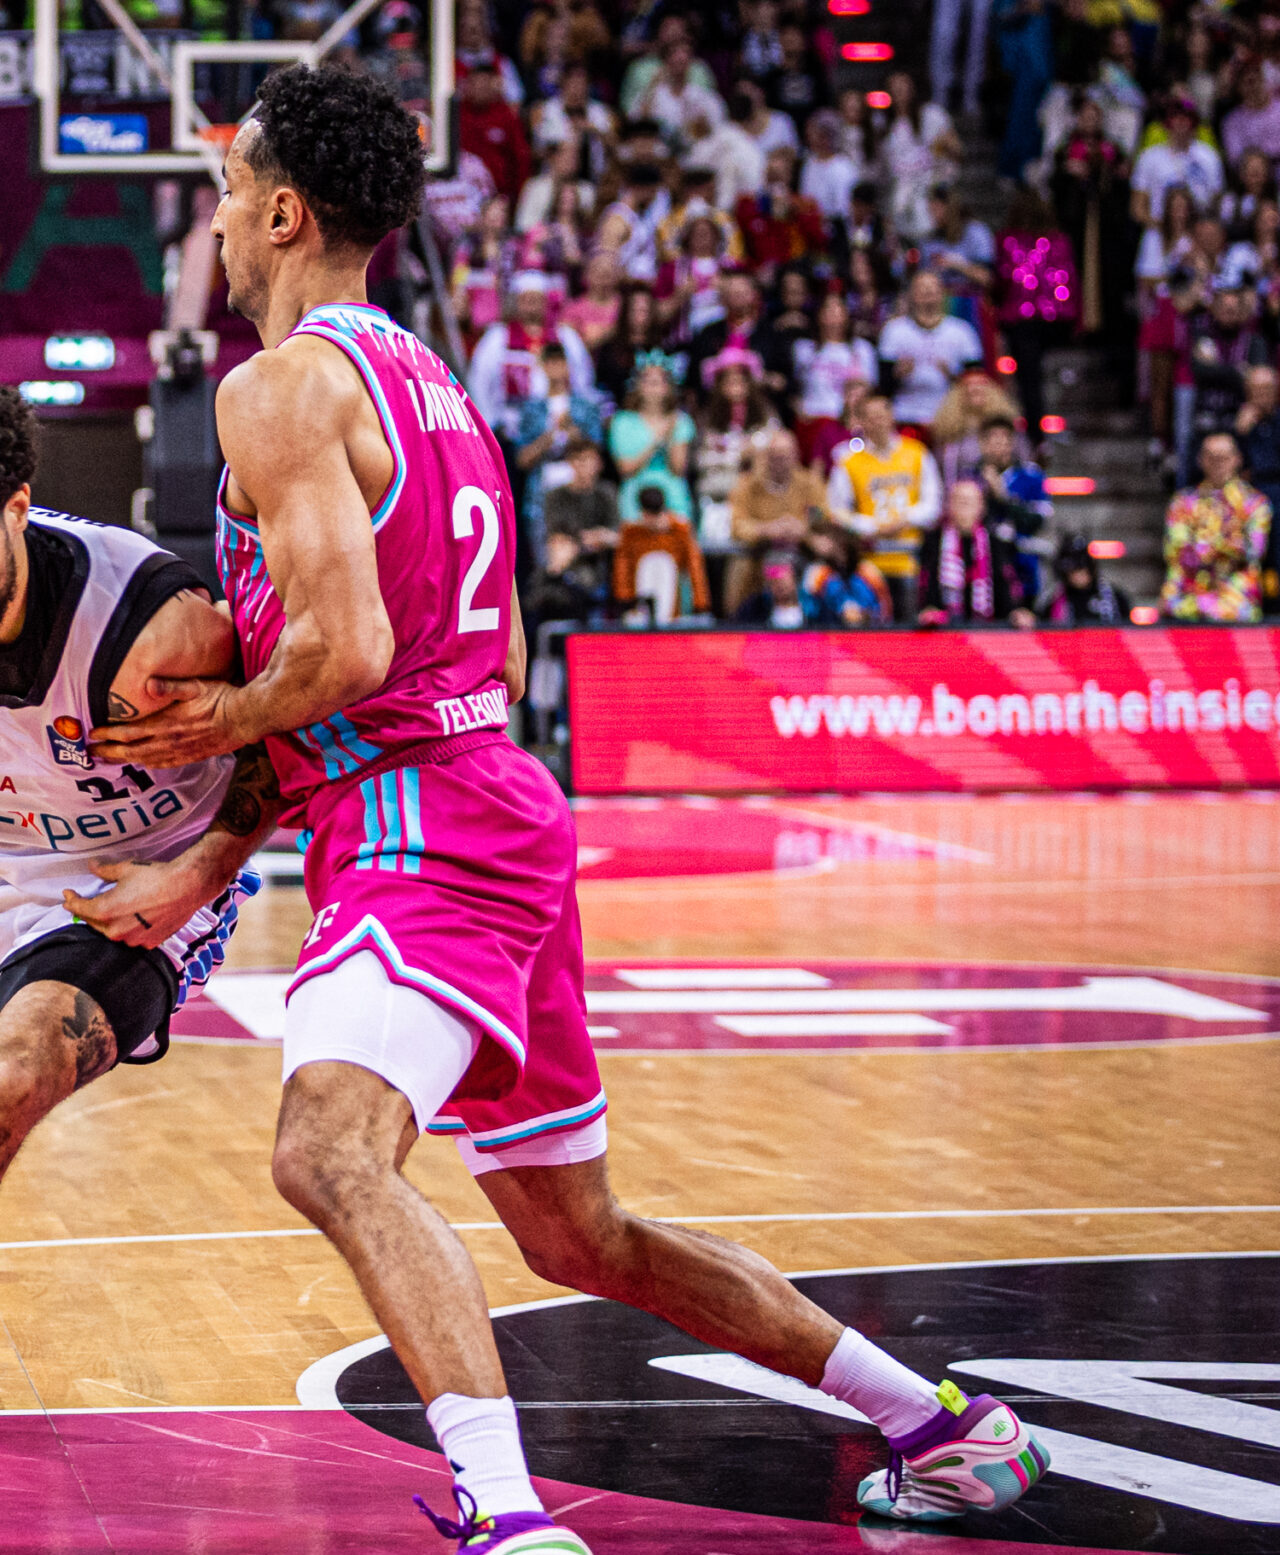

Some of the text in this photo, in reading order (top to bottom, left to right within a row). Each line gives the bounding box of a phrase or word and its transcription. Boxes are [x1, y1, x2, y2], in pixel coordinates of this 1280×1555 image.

[453, 485, 501, 634] 2
[770, 680, 1280, 738] www.bonnrheinsie
[58, 749, 93, 768] BBL
